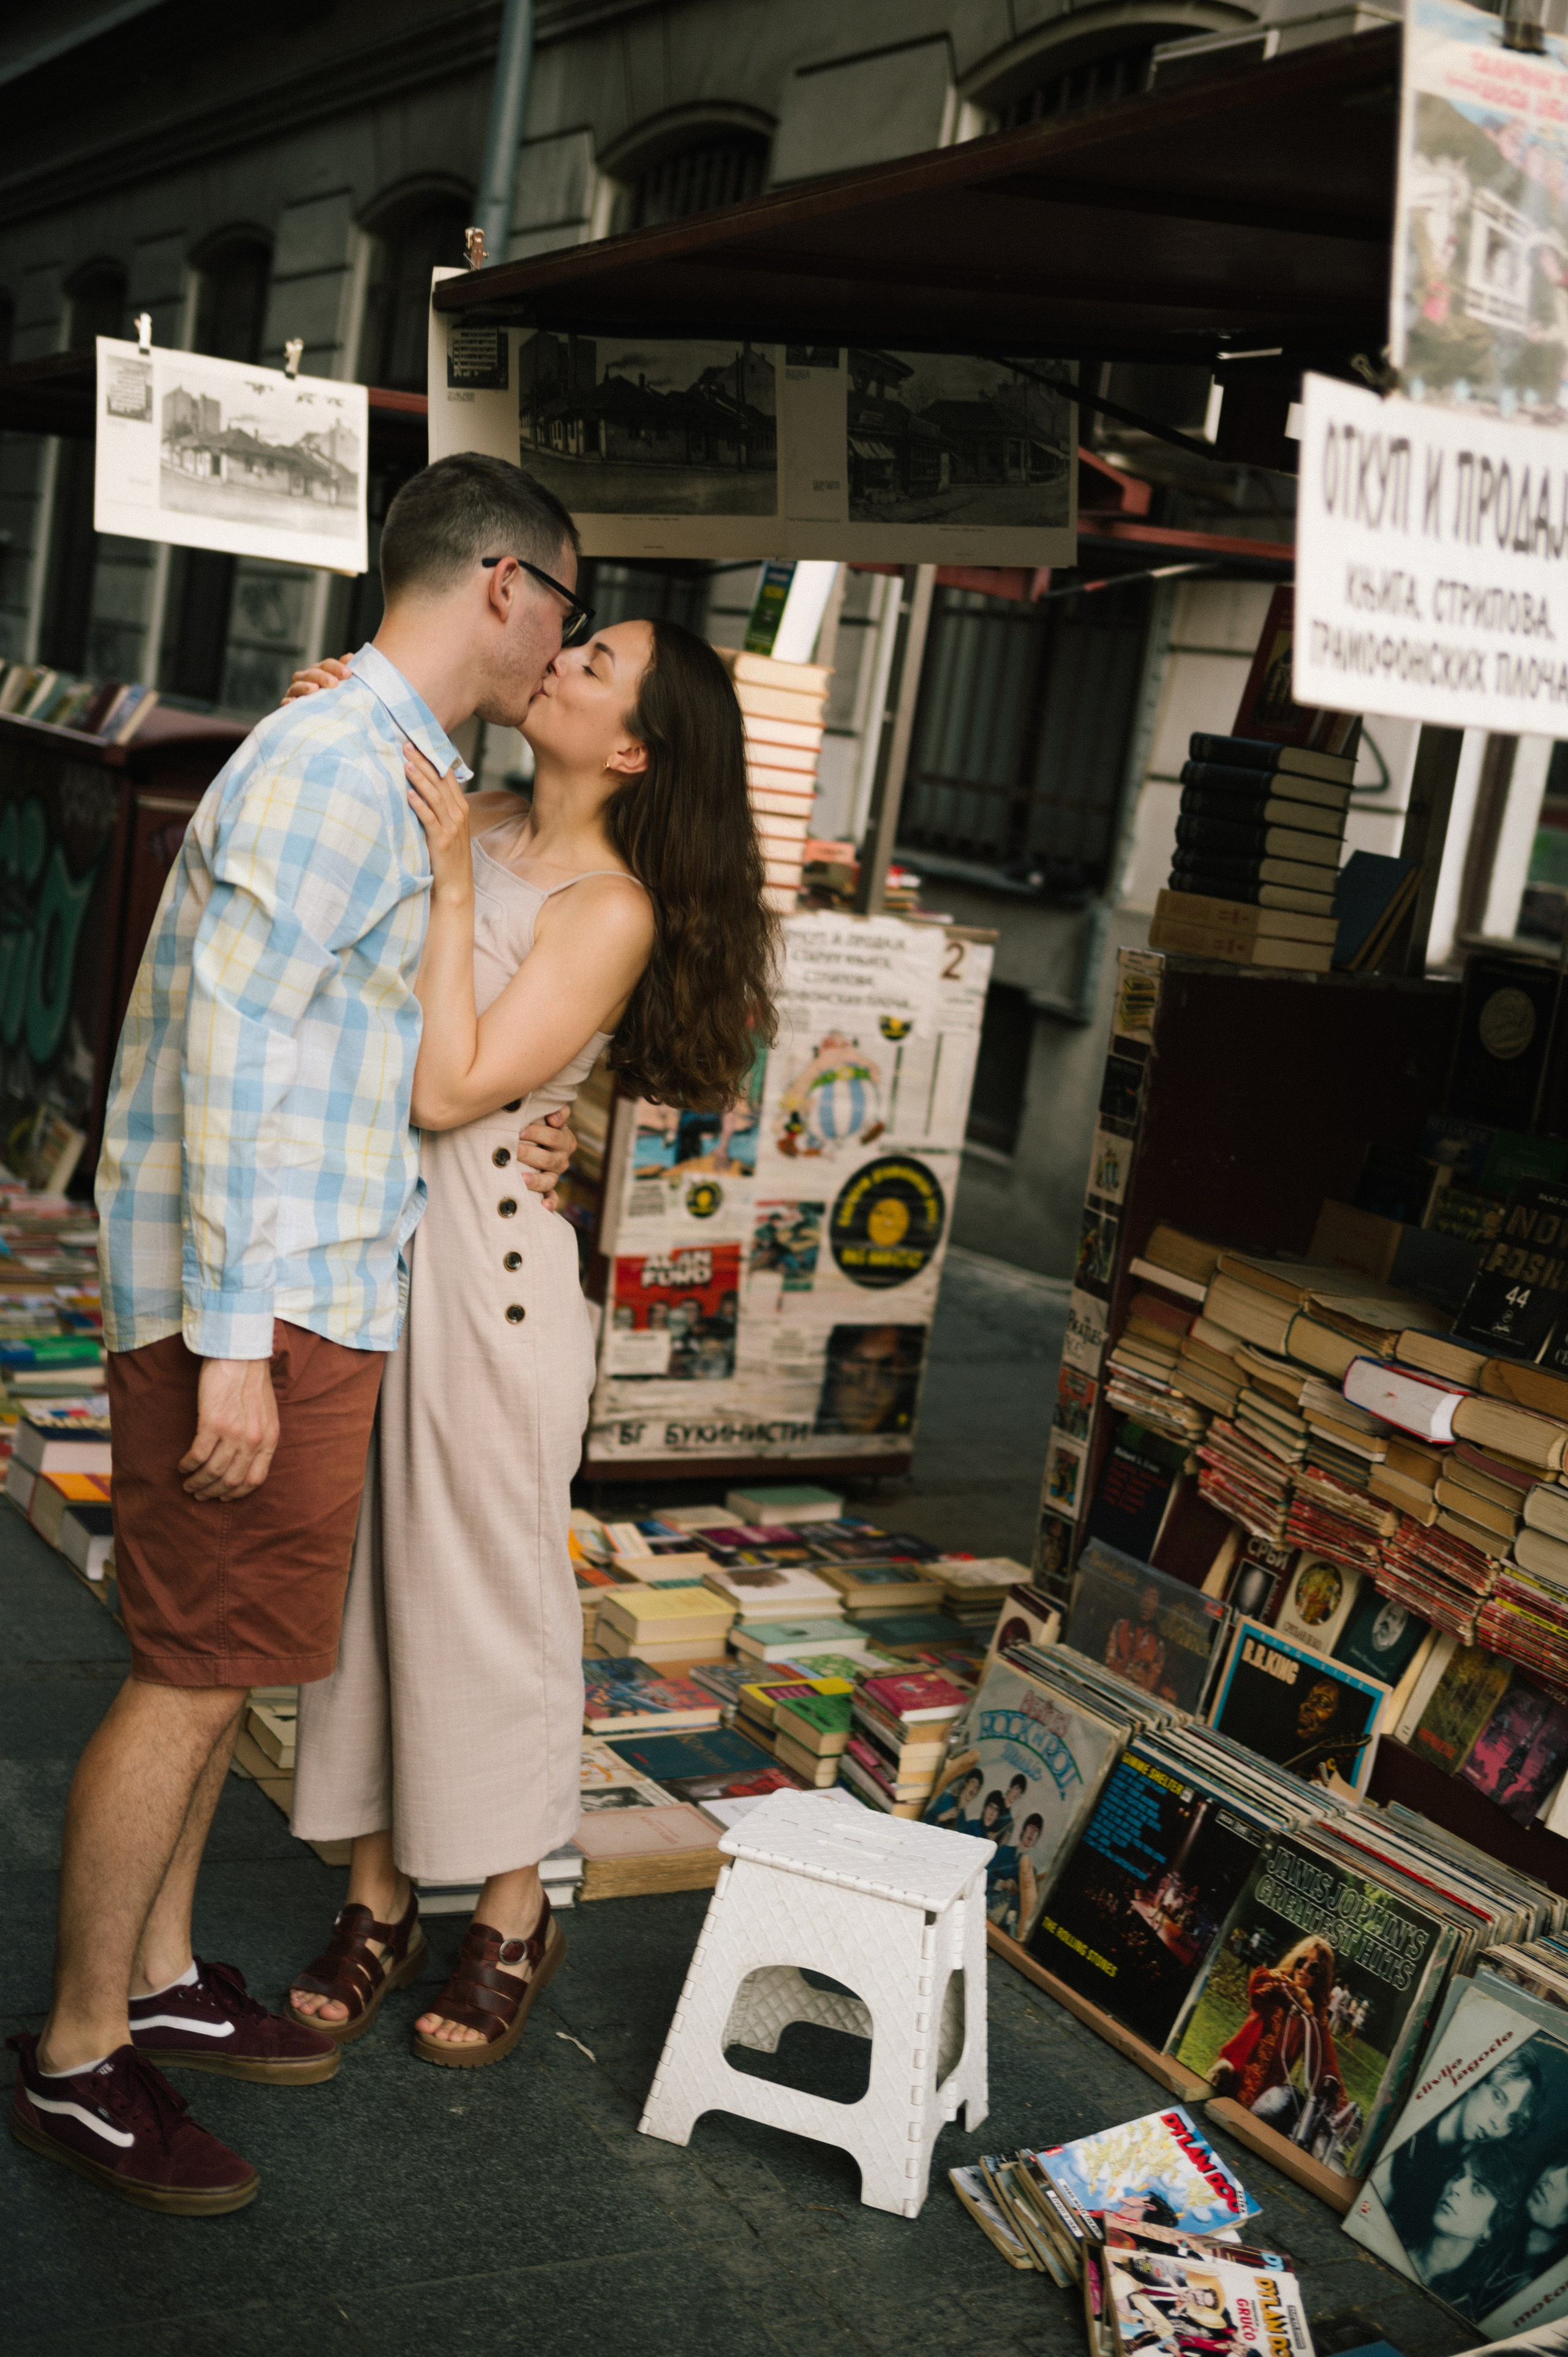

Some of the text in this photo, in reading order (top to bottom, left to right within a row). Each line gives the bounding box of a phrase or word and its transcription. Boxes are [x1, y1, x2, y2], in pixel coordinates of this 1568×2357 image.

[1323, 421, 1568, 560] ОТКУП И ПРОДАЈ
[940, 941, 965, 980] 2
[1505, 1286, 1532, 1309] 44
[619, 1420, 810, 1445] БГ БУКИНИСТИ
[1120, 1751, 1186, 1797] GIMME SHELTER
[1265, 1845, 1430, 1961] JANIS JOPLIN'S
[1041, 1915, 1119, 1978] THE ROLLING STONES
[1254, 1874, 1417, 1992] GREATEST HITS
[1160, 2112, 1219, 2174] DYLAN
[1236, 2298, 1259, 2341] GRUČO
[1254, 2276, 1289, 2335] DYLAN
[1513, 2280, 1568, 2328] moto
[1267, 2334, 1294, 2357] DO
